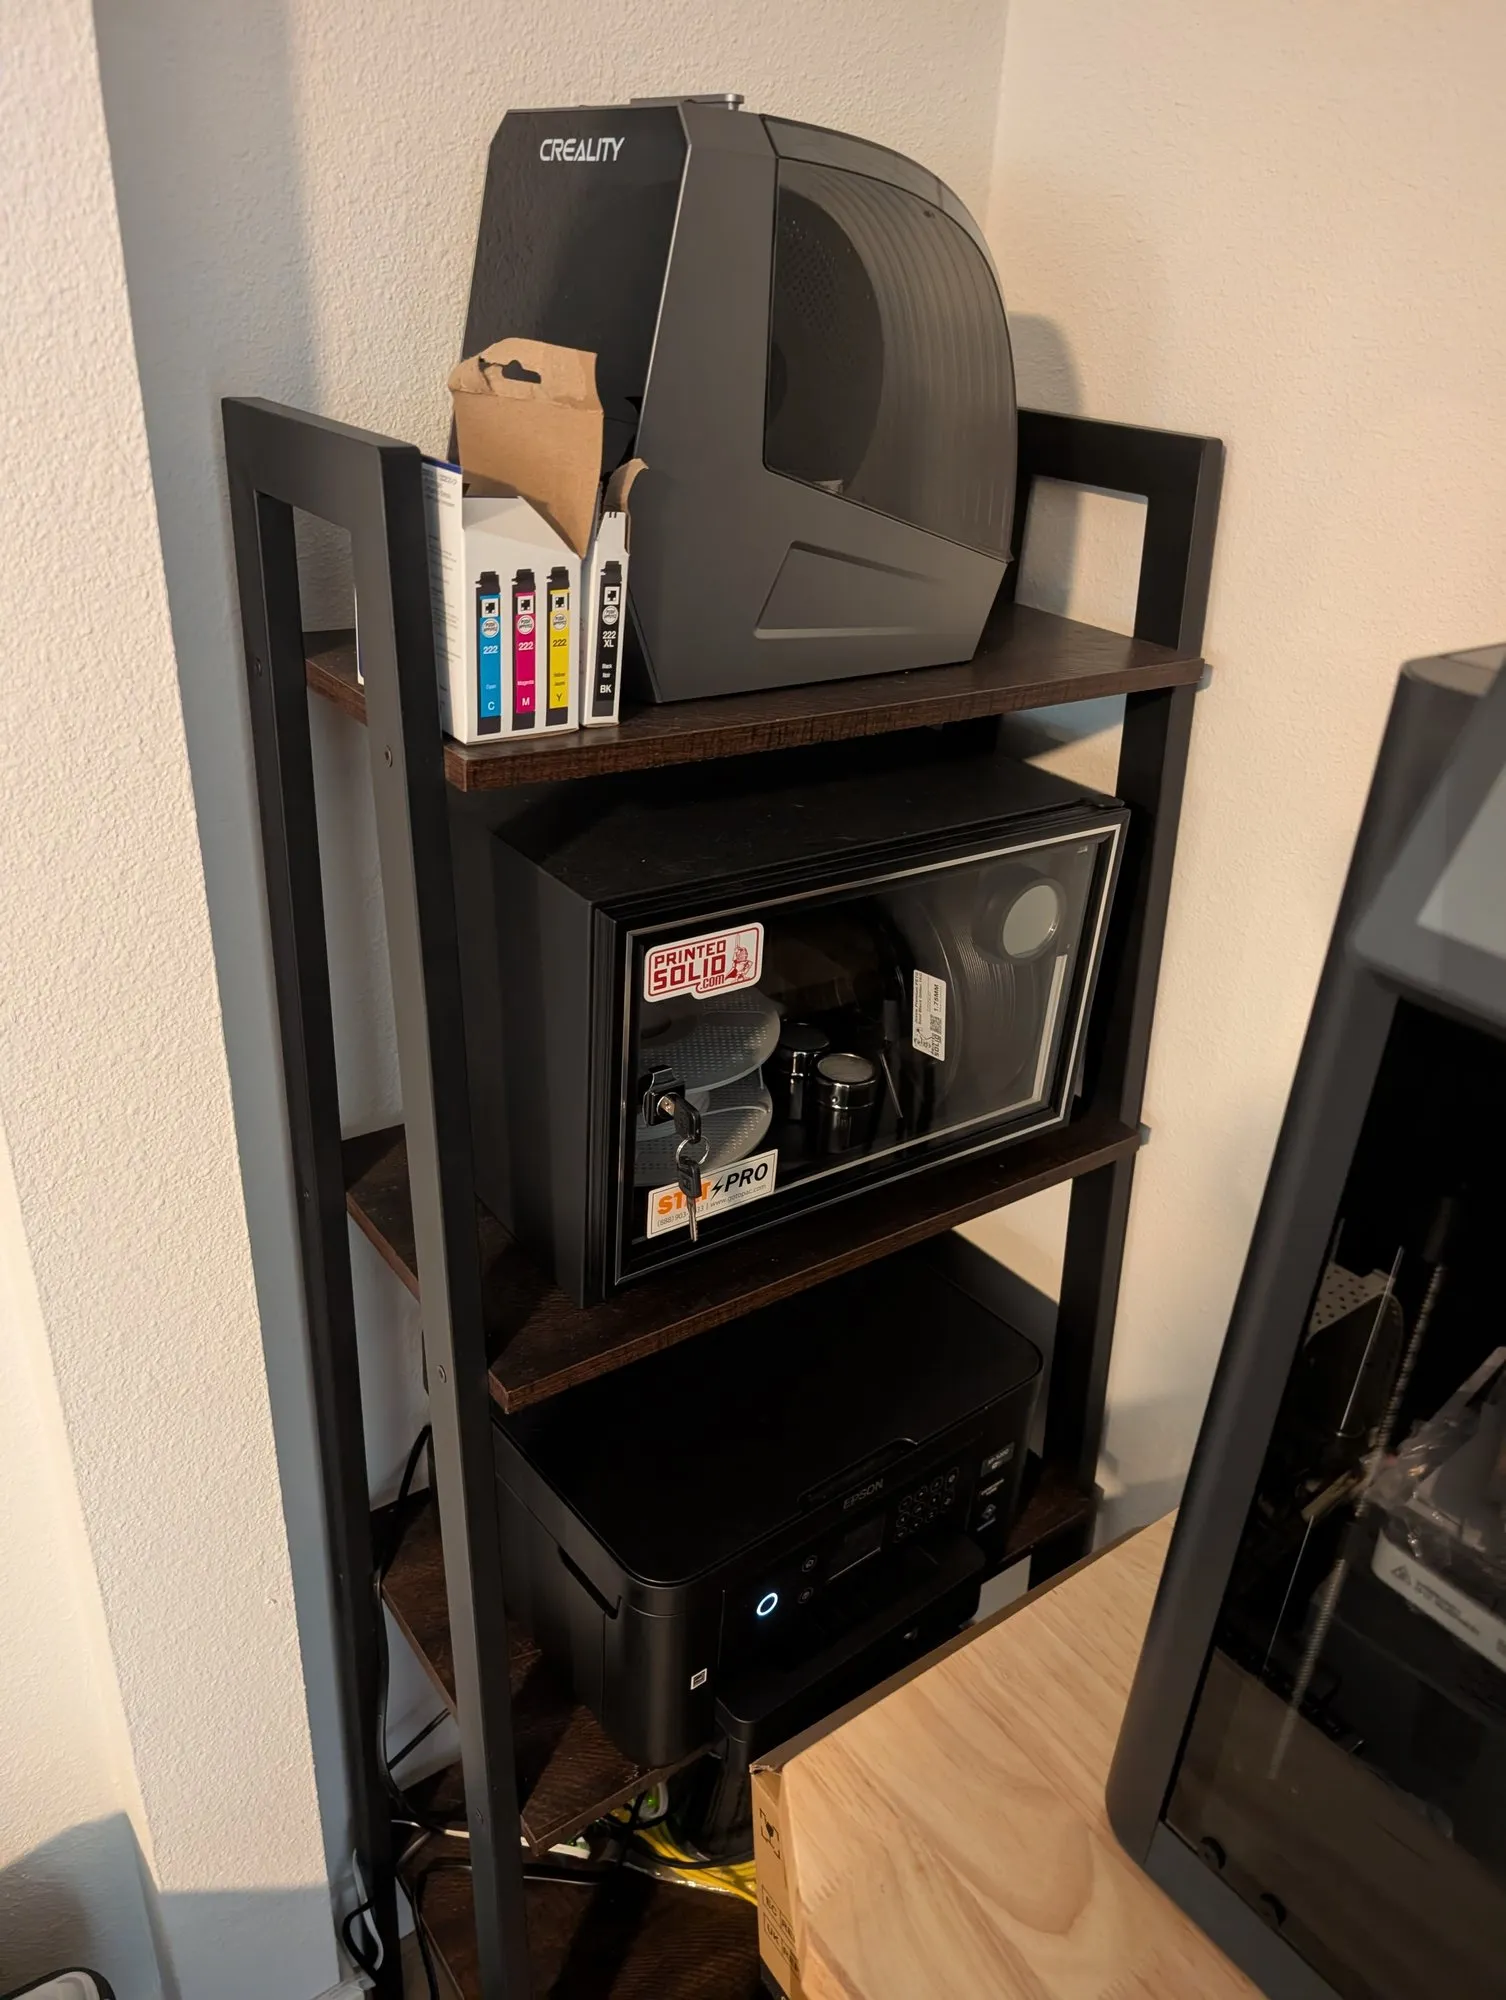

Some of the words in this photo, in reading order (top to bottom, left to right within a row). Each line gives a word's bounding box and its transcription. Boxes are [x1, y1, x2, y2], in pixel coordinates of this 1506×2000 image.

[540, 137, 625, 162] CREALITY
[602, 630, 616, 640] 222
[518, 641, 534, 651] 222
[552, 638, 567, 648] 222
[603, 639, 614, 648] XL
[483, 645, 499, 655] 222
[599, 684, 612, 694] BK
[521, 697, 530, 706] M
[556, 693, 563, 702] Y
[487, 701, 495, 711] C
[654, 939, 727, 969] PRINTED
[653, 954, 726, 991] SOLID
[700, 974, 725, 990] .com
[724, 1162, 769, 1193] PRO
[710, 1184, 767, 1208] www.gotopac.com
[843, 1477, 884, 1510] EPSON
[765, 1895, 777, 1917] EC
[766, 1923, 779, 1946] UK
